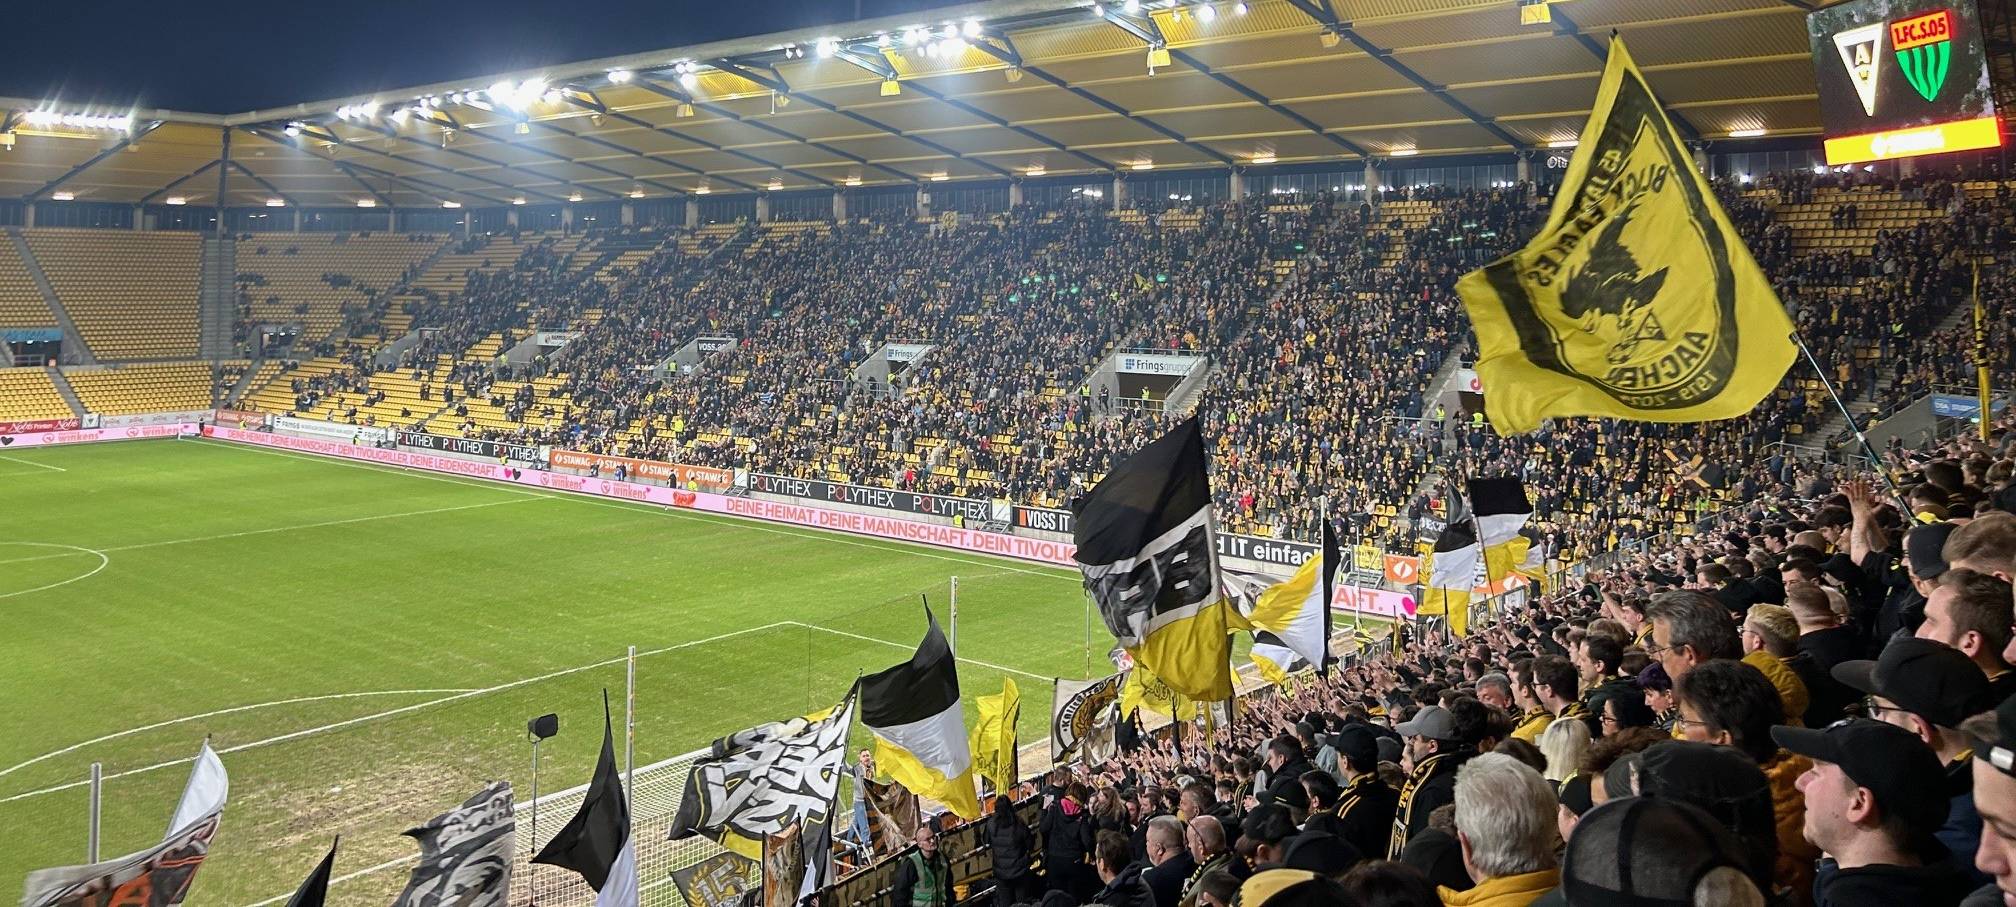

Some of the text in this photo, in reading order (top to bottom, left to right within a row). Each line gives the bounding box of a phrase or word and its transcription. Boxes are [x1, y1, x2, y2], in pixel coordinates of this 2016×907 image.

[409, 455, 434, 468] DEINE
[563, 454, 591, 467] STAWAG
[613, 484, 648, 500] winkens
[750, 475, 813, 497] POLYTHEX
[827, 484, 895, 508] POLYTHEX
[726, 498, 765, 517] DEINE
[819, 512, 861, 530] DEINE
[972, 532, 1011, 553] DEIN
[1026, 508, 1071, 532] VOSS IT
[1230, 537, 1249, 557] IT
[1253, 541, 1319, 565] einfac
